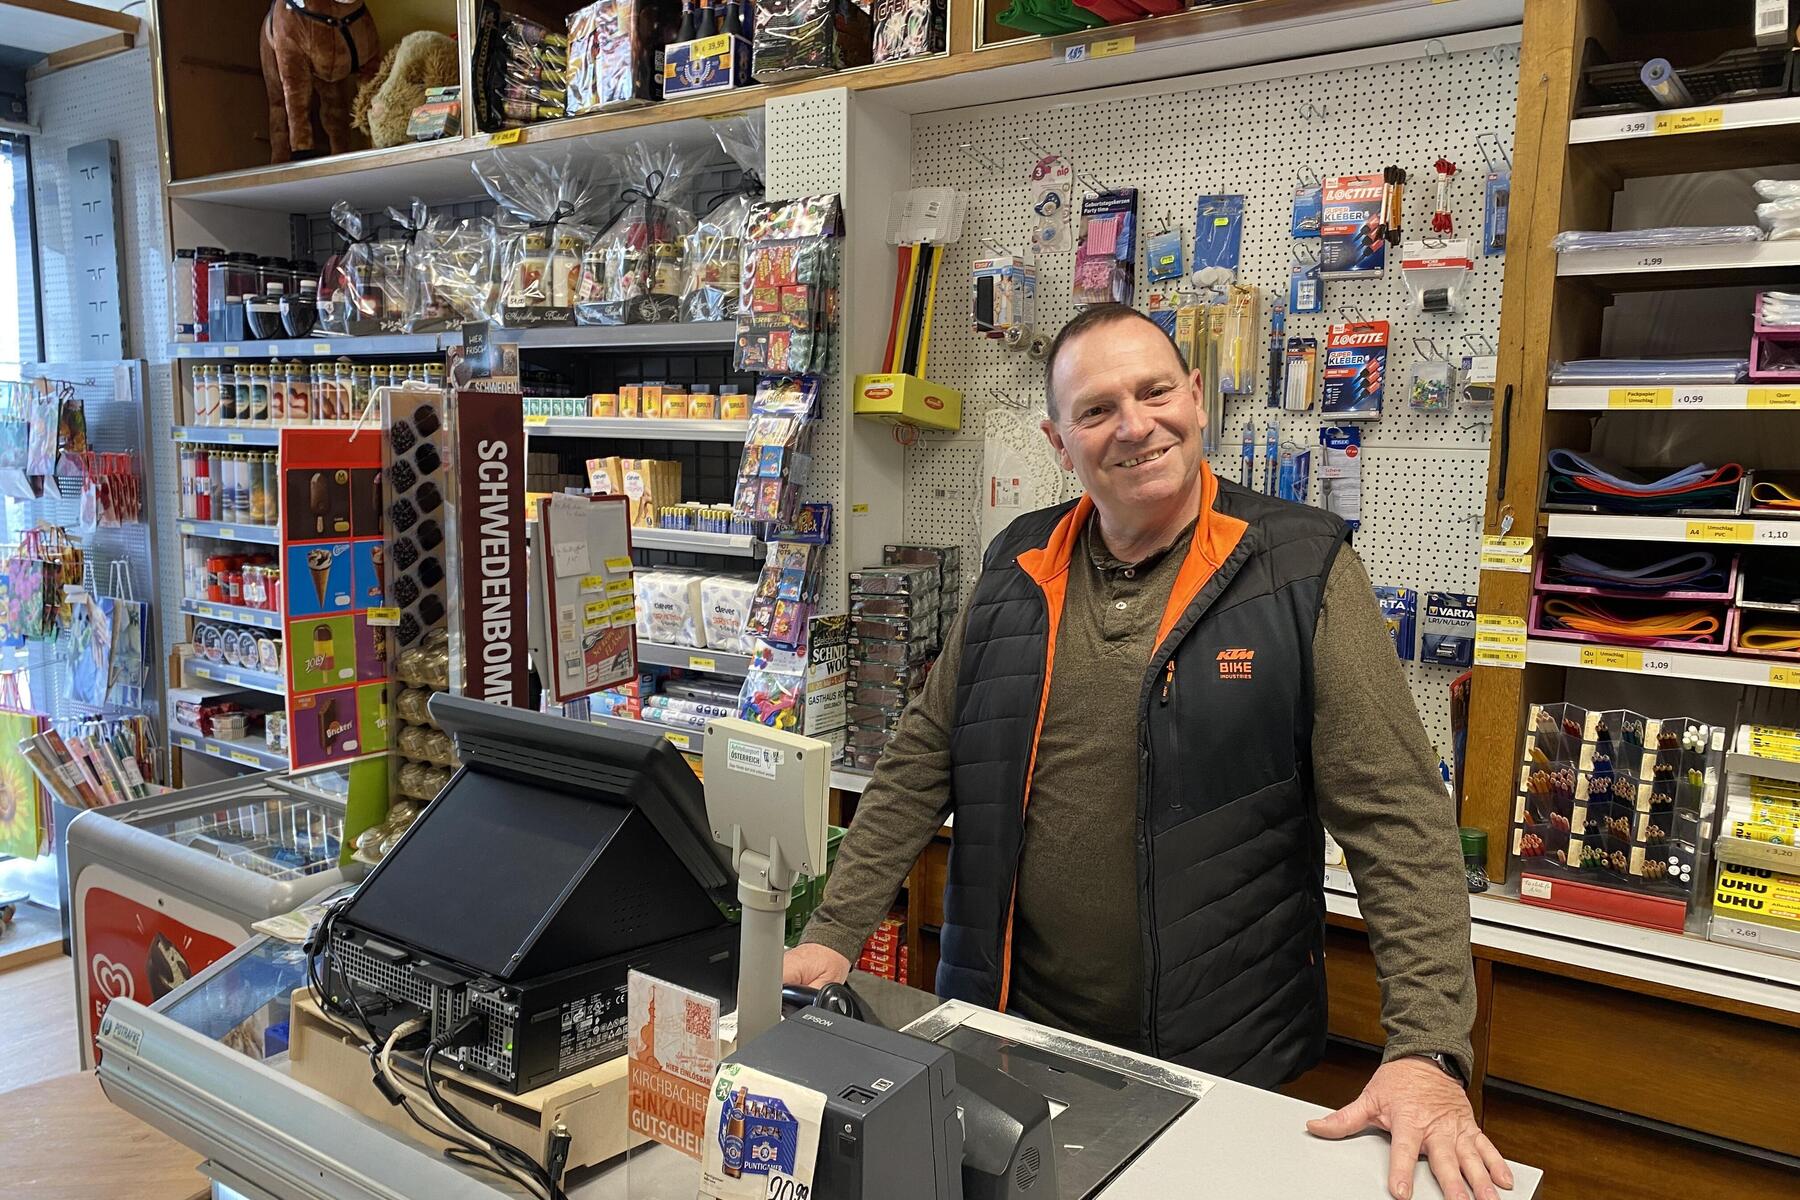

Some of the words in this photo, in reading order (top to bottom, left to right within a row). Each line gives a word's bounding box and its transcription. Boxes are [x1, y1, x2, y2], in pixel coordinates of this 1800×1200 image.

[1626, 123, 1645, 132] 3,99
[1035, 168, 1043, 176] 3
[1056, 166, 1070, 177] nip
[1325, 187, 1382, 200] LOCTITE
[1084, 198, 1130, 208] Geburtstagskerzen
[1324, 212, 1363, 221] KLEBER
[1643, 258, 1663, 266] 1,99
[1331, 333, 1384, 346] LOCTITE
[1328, 356, 1365, 366] KLEBER
[1683, 395, 1704, 404] 0,99
[1768, 531, 1789, 539] 1,10
[714, 605, 735, 616] clever
[1439, 607, 1475, 619] VARTA
[1428, 618, 1471, 627] LR1/N/LADY
[1215, 648, 1255, 661] KTM
[305, 653, 327, 673] JOLLY
[1219, 662, 1252, 673] BIKE
[1650, 661, 1669, 670] 1,09
[807, 691, 837, 706] GASTHAUS
[730, 750, 760, 765] ÖSTERREICH
[1726, 863, 1772, 879] UHU
[1720, 878, 1768, 894] UHU
[1716, 893, 1764, 909] UHU
[1736, 928, 1757, 937] 2,69
[801, 1013, 834, 1027] EPSON
[665, 1061, 680, 1074] HIER
[679, 1068, 712, 1086] EINLÖSBAR
